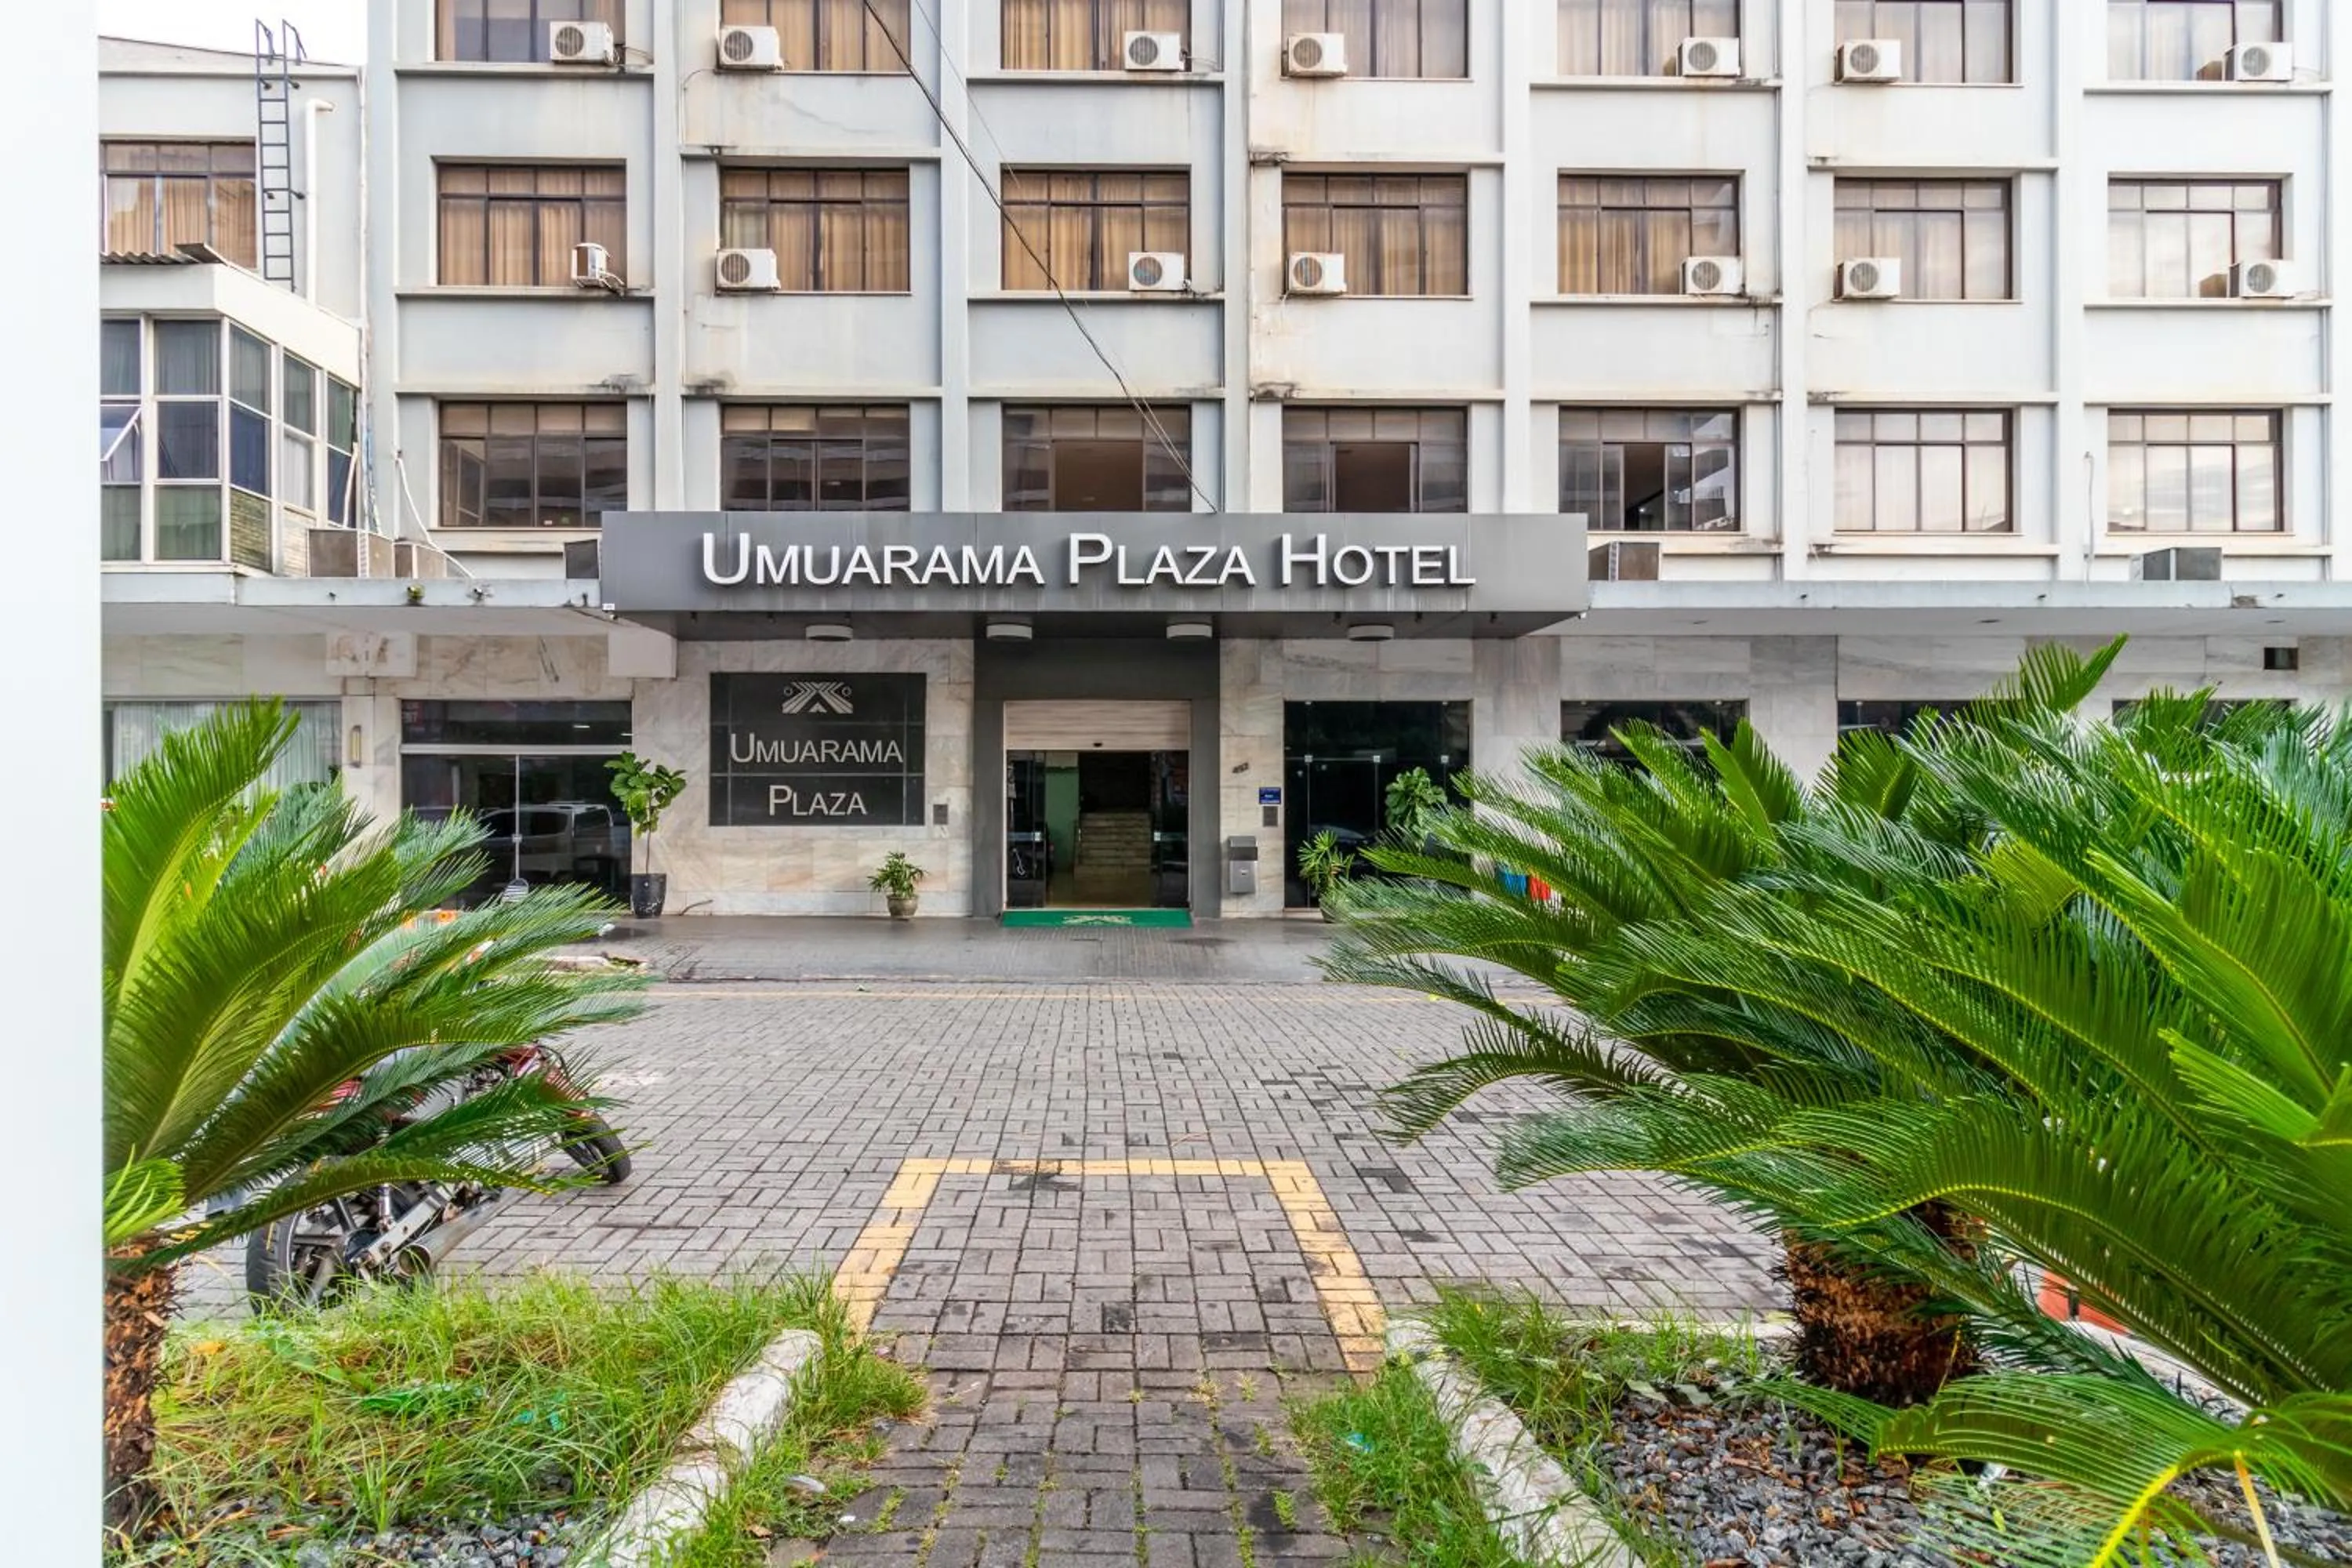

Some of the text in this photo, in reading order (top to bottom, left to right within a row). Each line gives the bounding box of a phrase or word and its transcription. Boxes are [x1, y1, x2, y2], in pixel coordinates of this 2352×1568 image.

[702, 532, 1477, 585] UMUARAMA PLAZA HOTEL
[730, 732, 904, 764] UMUARAMA
[768, 784, 867, 816] PLAZA
